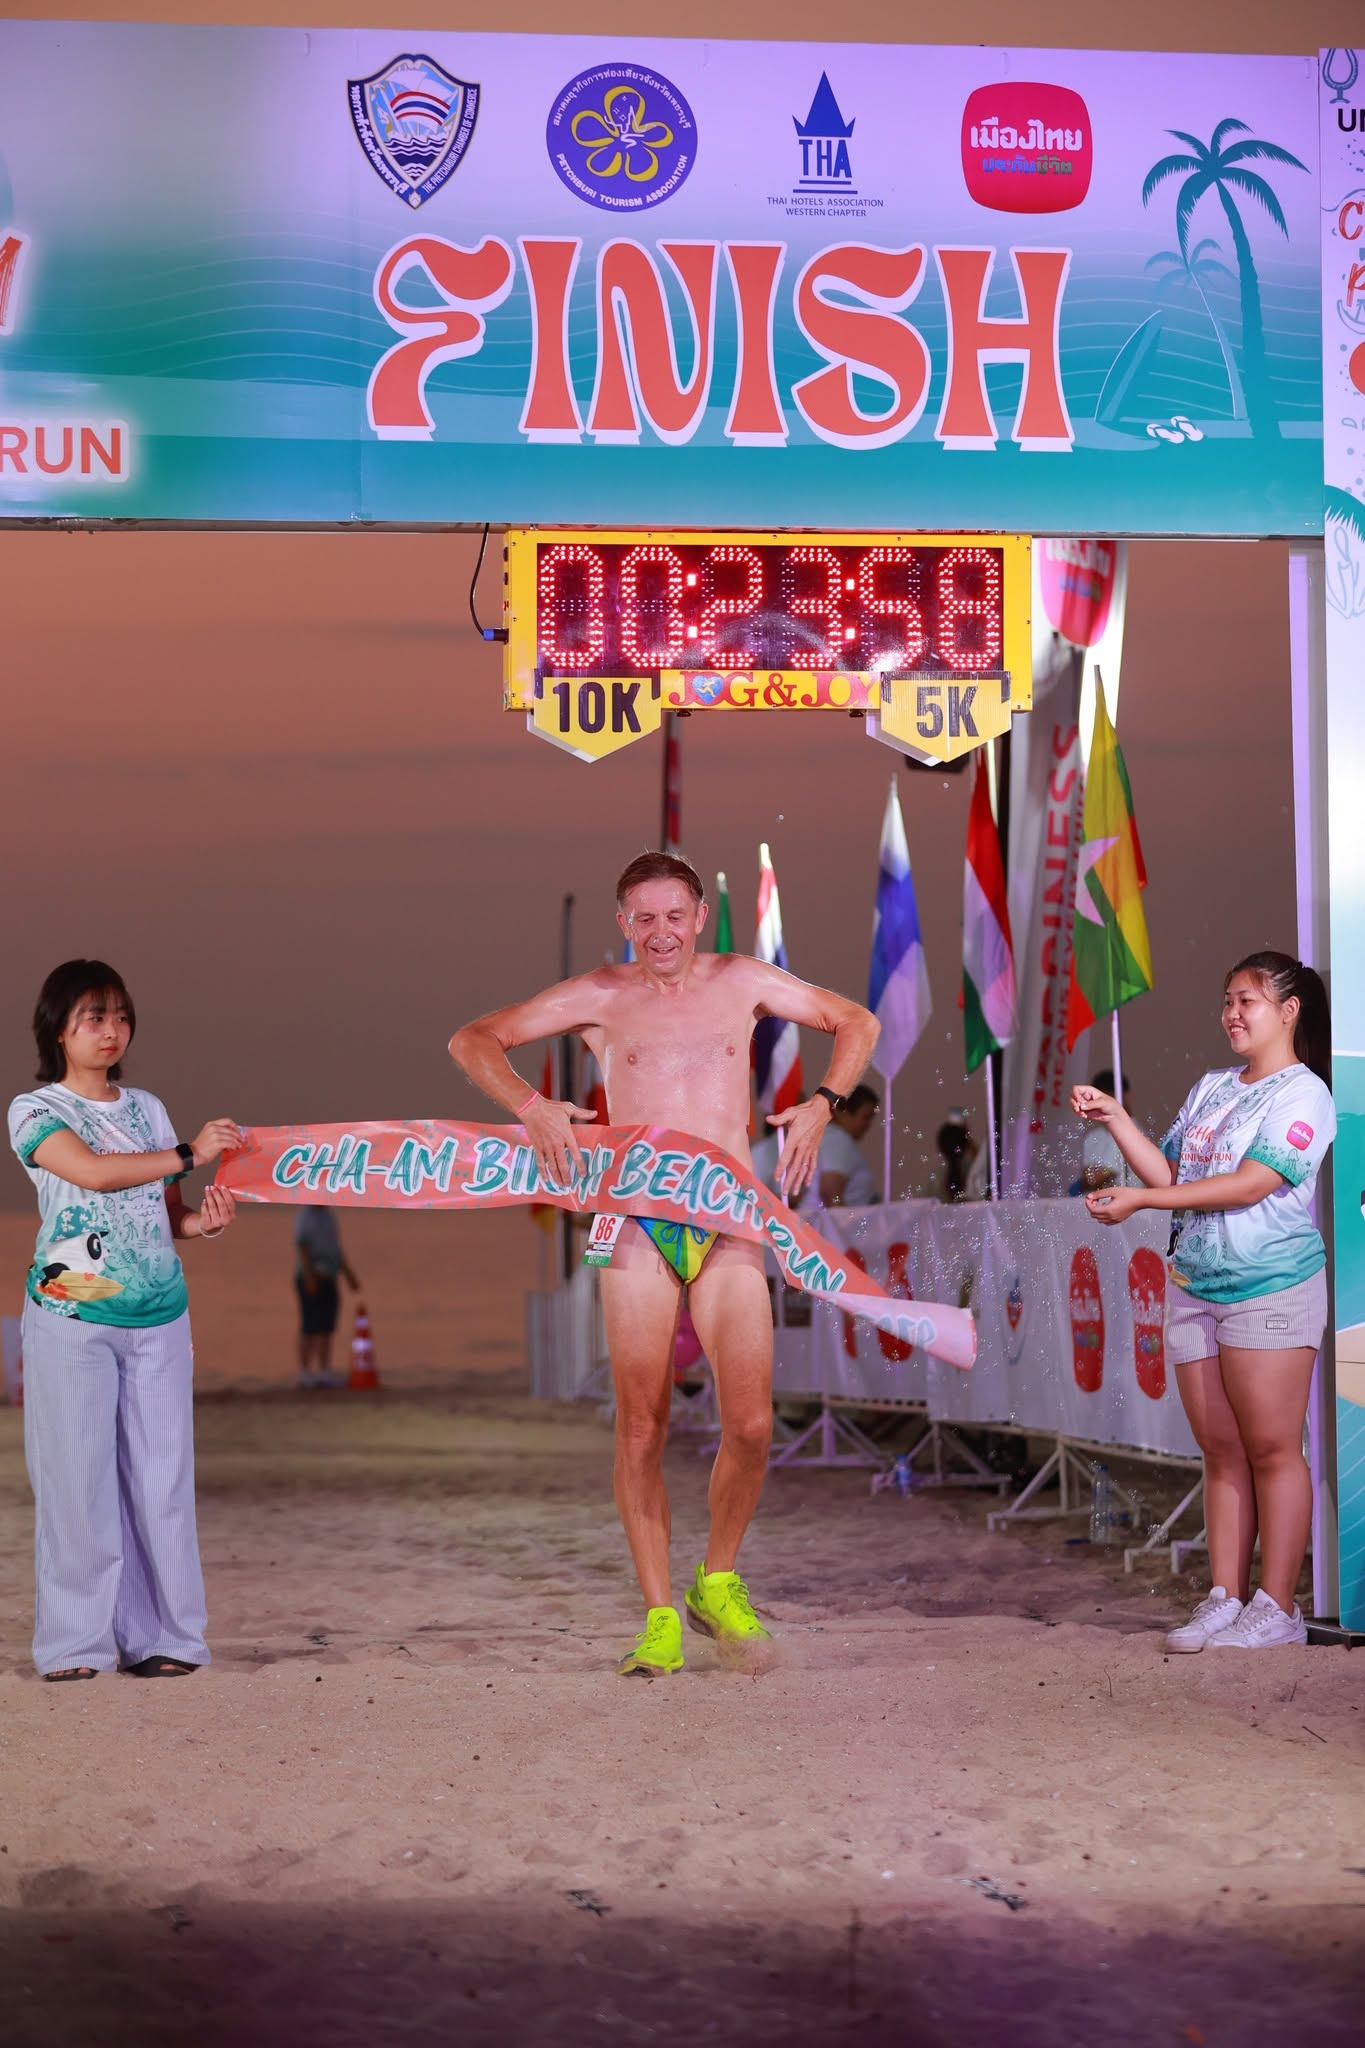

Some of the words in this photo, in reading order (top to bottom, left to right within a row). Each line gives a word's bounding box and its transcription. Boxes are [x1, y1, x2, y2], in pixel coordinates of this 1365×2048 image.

[464, 88, 478, 120] COMMERCE
[453, 126, 470, 154] CHAMBER
[462, 118, 473, 128] OF
[970, 116, 1083, 151] เมืองไทย
[799, 139, 852, 178] THA
[421, 183, 435, 194] THE
[556, 153, 597, 199] PETCHBURI
[600, 193, 643, 207] TOURISM
[646, 154, 688, 204] ASSOCIATION
[767, 196, 788, 205] THAI
[791, 197, 824, 206] HOTELS
[827, 198, 884, 207] ASSOCIATION
[785, 207, 826, 216] WESTERN
[827, 208, 867, 217] CHAPTER
[367, 235, 1075, 453] FINISH
[0, 426, 122, 475] RUN
[541, 546, 999, 667] 00:23:58
[552, 681, 642, 733] 10K
[763, 672, 797, 707] &
[801, 672, 876, 707] JOY
[916, 685, 980, 738] 5K
[273, 1135, 458, 1195] CHA-AM
[594, 1216, 617, 1242] 86
